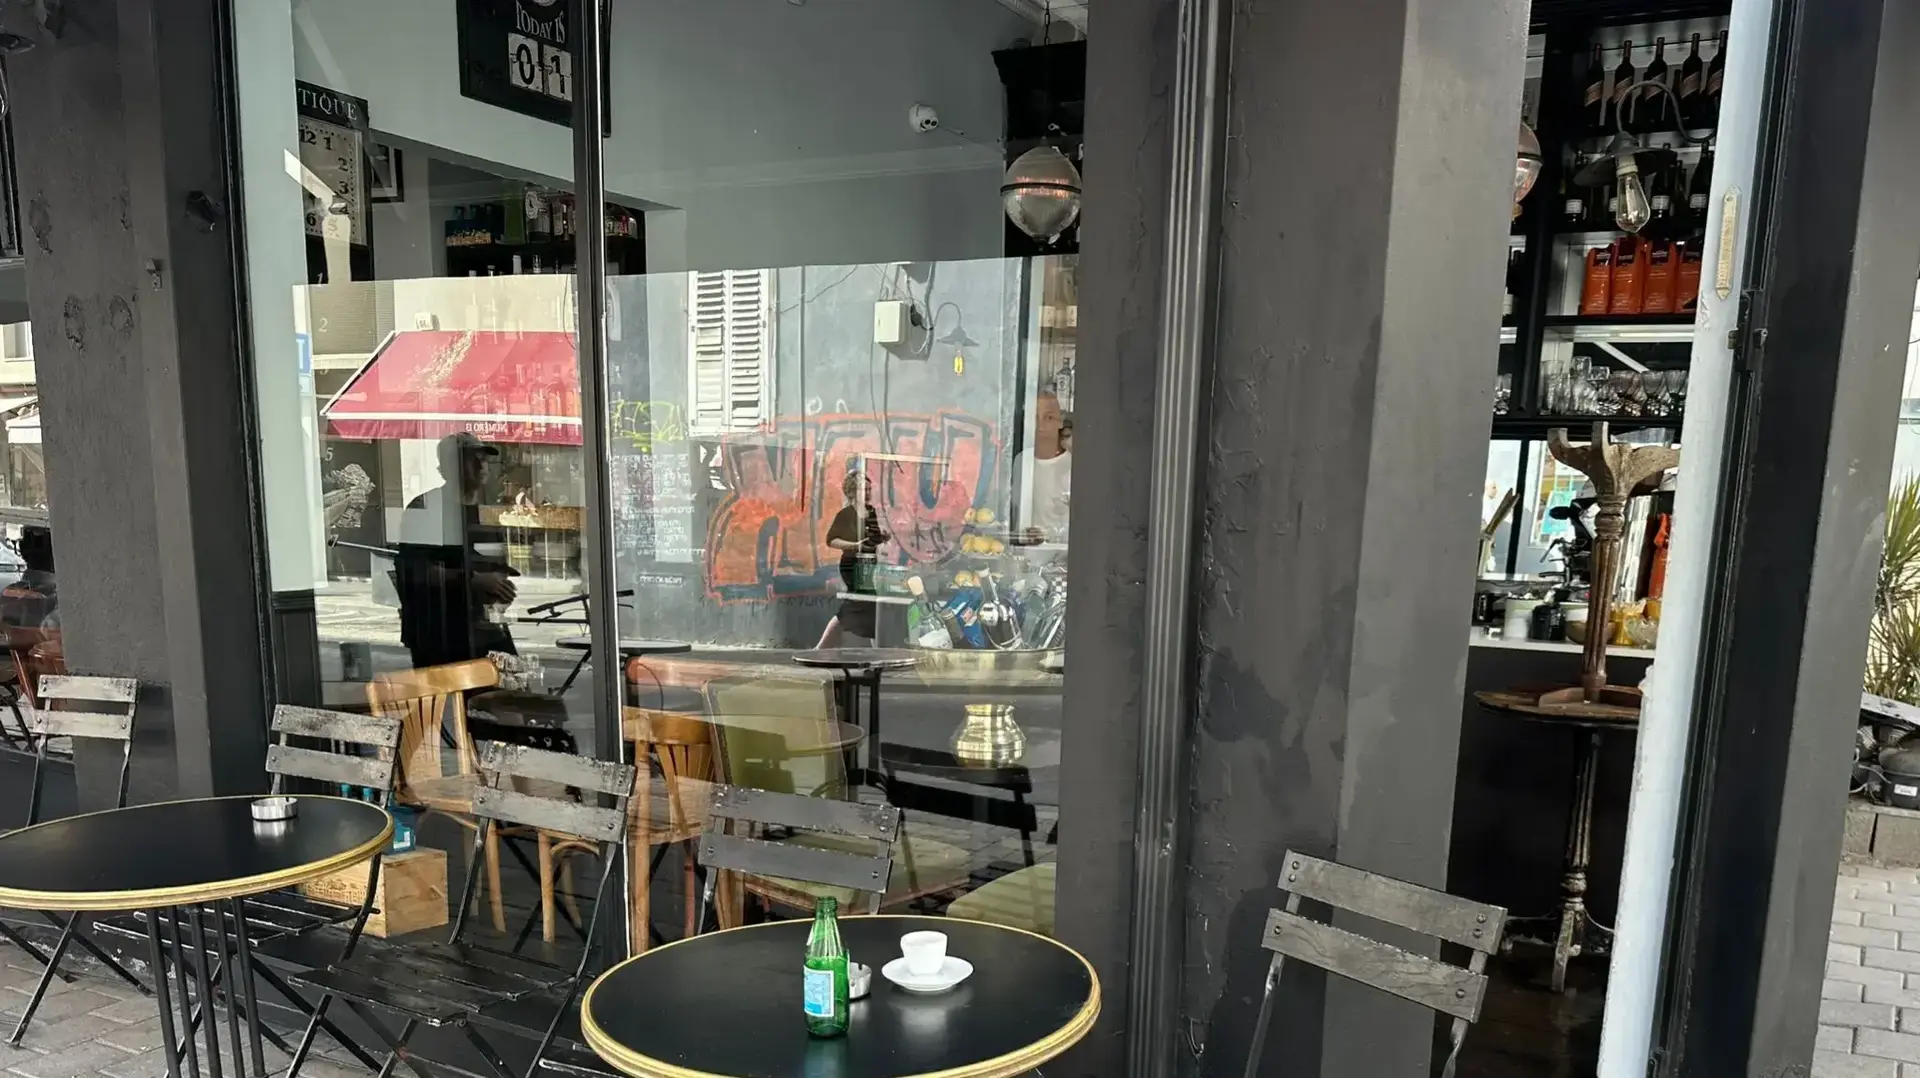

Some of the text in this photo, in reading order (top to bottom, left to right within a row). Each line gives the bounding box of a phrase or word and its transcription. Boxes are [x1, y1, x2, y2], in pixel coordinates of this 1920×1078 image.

[515, 0, 566, 44] TODAY IS
[323, 136, 332, 151] 1
[338, 157, 349, 172] 2
[339, 180, 349, 194] 3
[305, 212, 317, 227] 6
[318, 316, 329, 333] 2
[324, 446, 334, 462] 5
